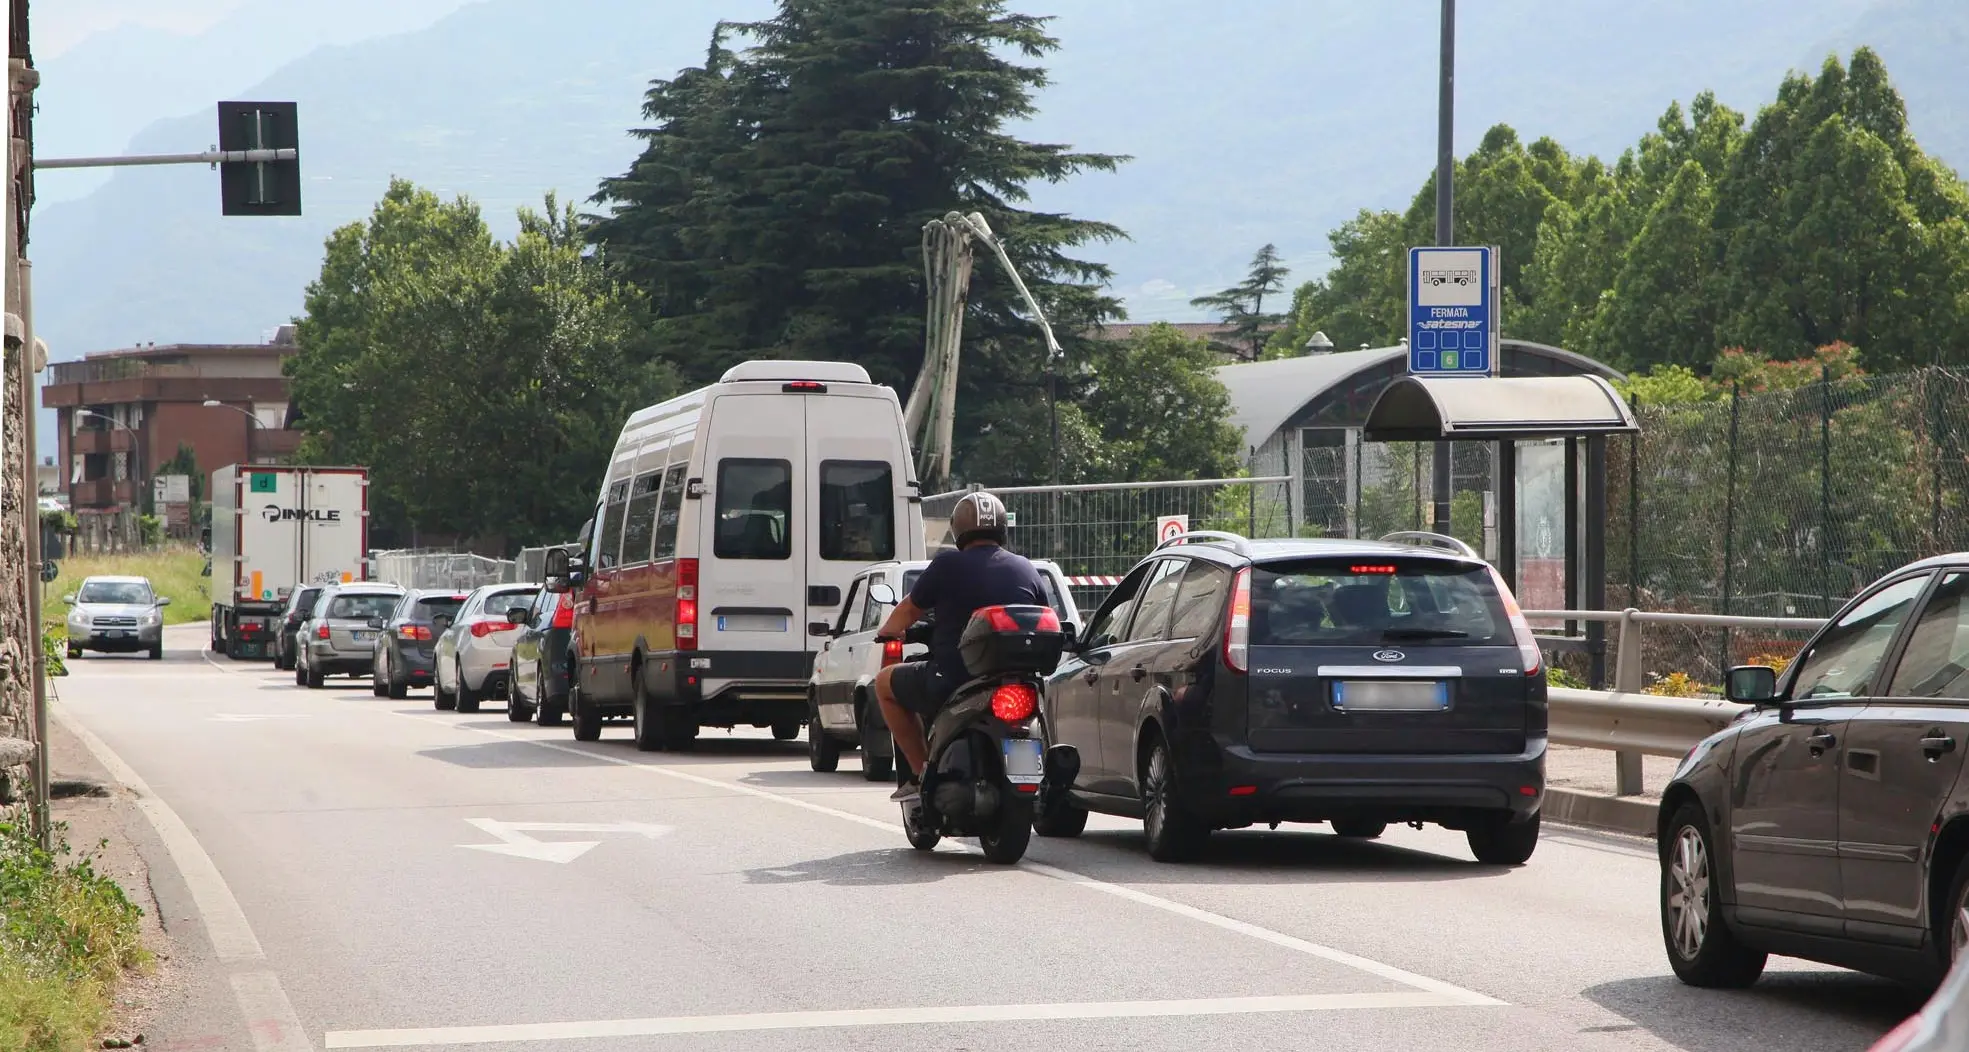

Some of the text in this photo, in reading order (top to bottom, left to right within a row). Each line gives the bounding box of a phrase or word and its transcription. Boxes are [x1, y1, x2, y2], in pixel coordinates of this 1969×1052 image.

[1431, 307, 1468, 318] FERMATA
[1446, 355, 1453, 365] 6
[260, 478, 268, 489] d
[262, 504, 341, 523] PINKLE
